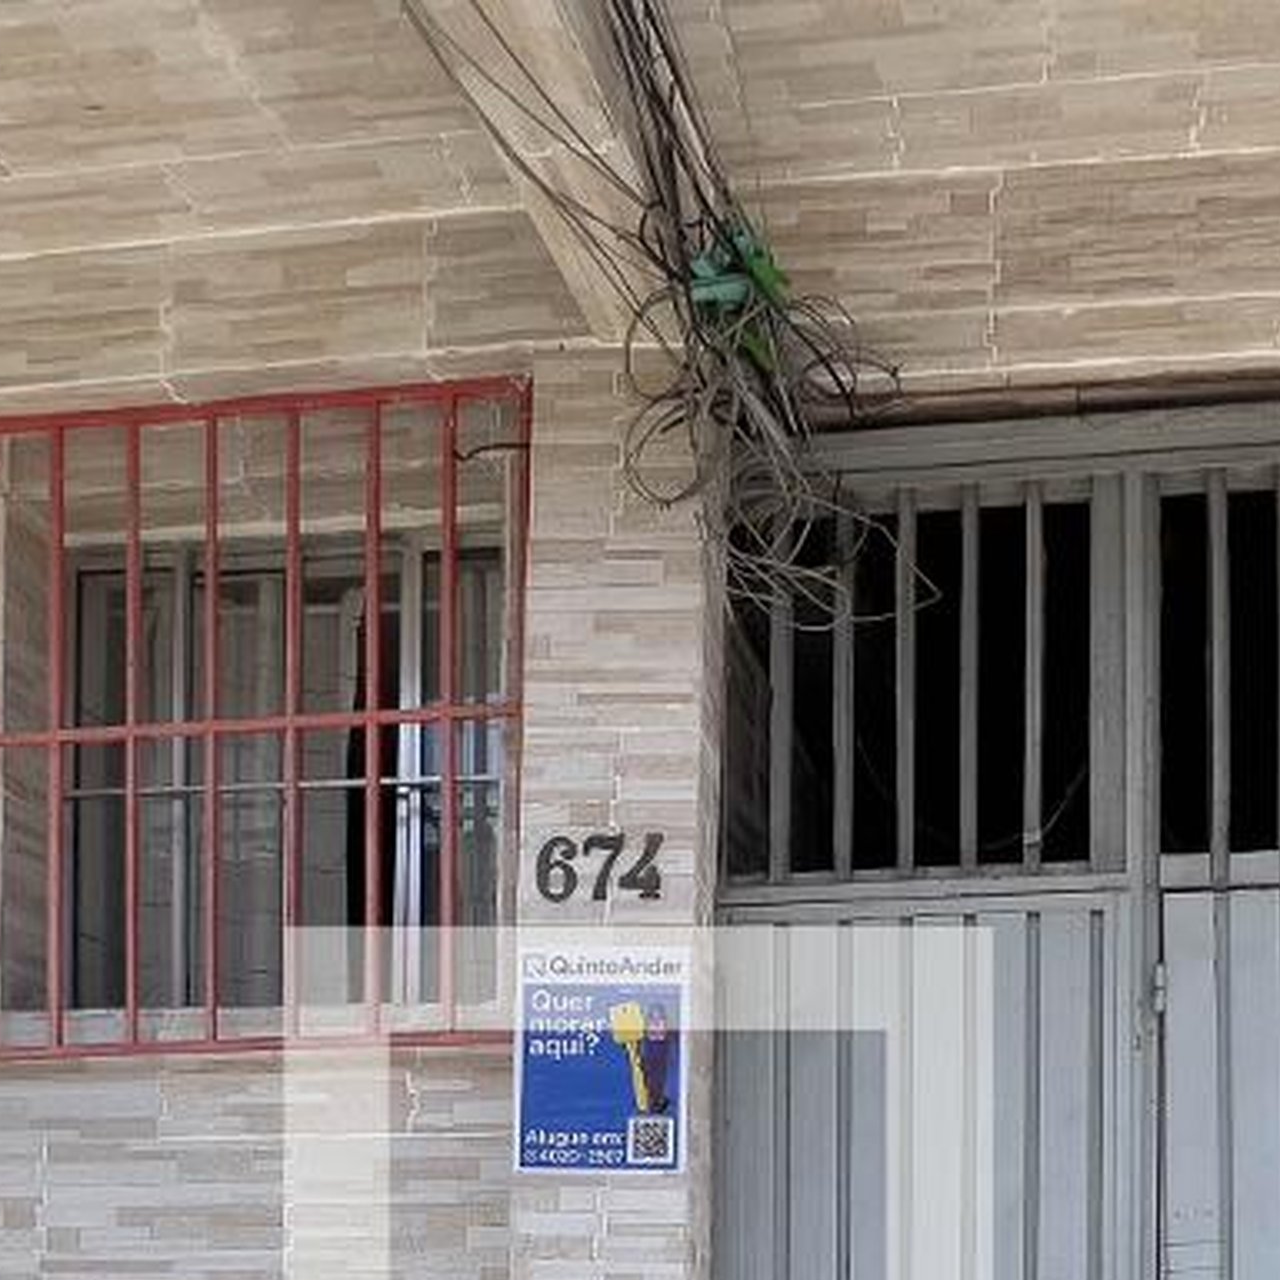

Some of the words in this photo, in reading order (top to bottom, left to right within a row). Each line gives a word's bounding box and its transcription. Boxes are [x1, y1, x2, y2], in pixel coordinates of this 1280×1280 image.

[536, 832, 664, 903] 674
[531, 989, 593, 1012] Quer
[529, 1017, 608, 1034] morar
[528, 1033, 600, 1060] aqui?
